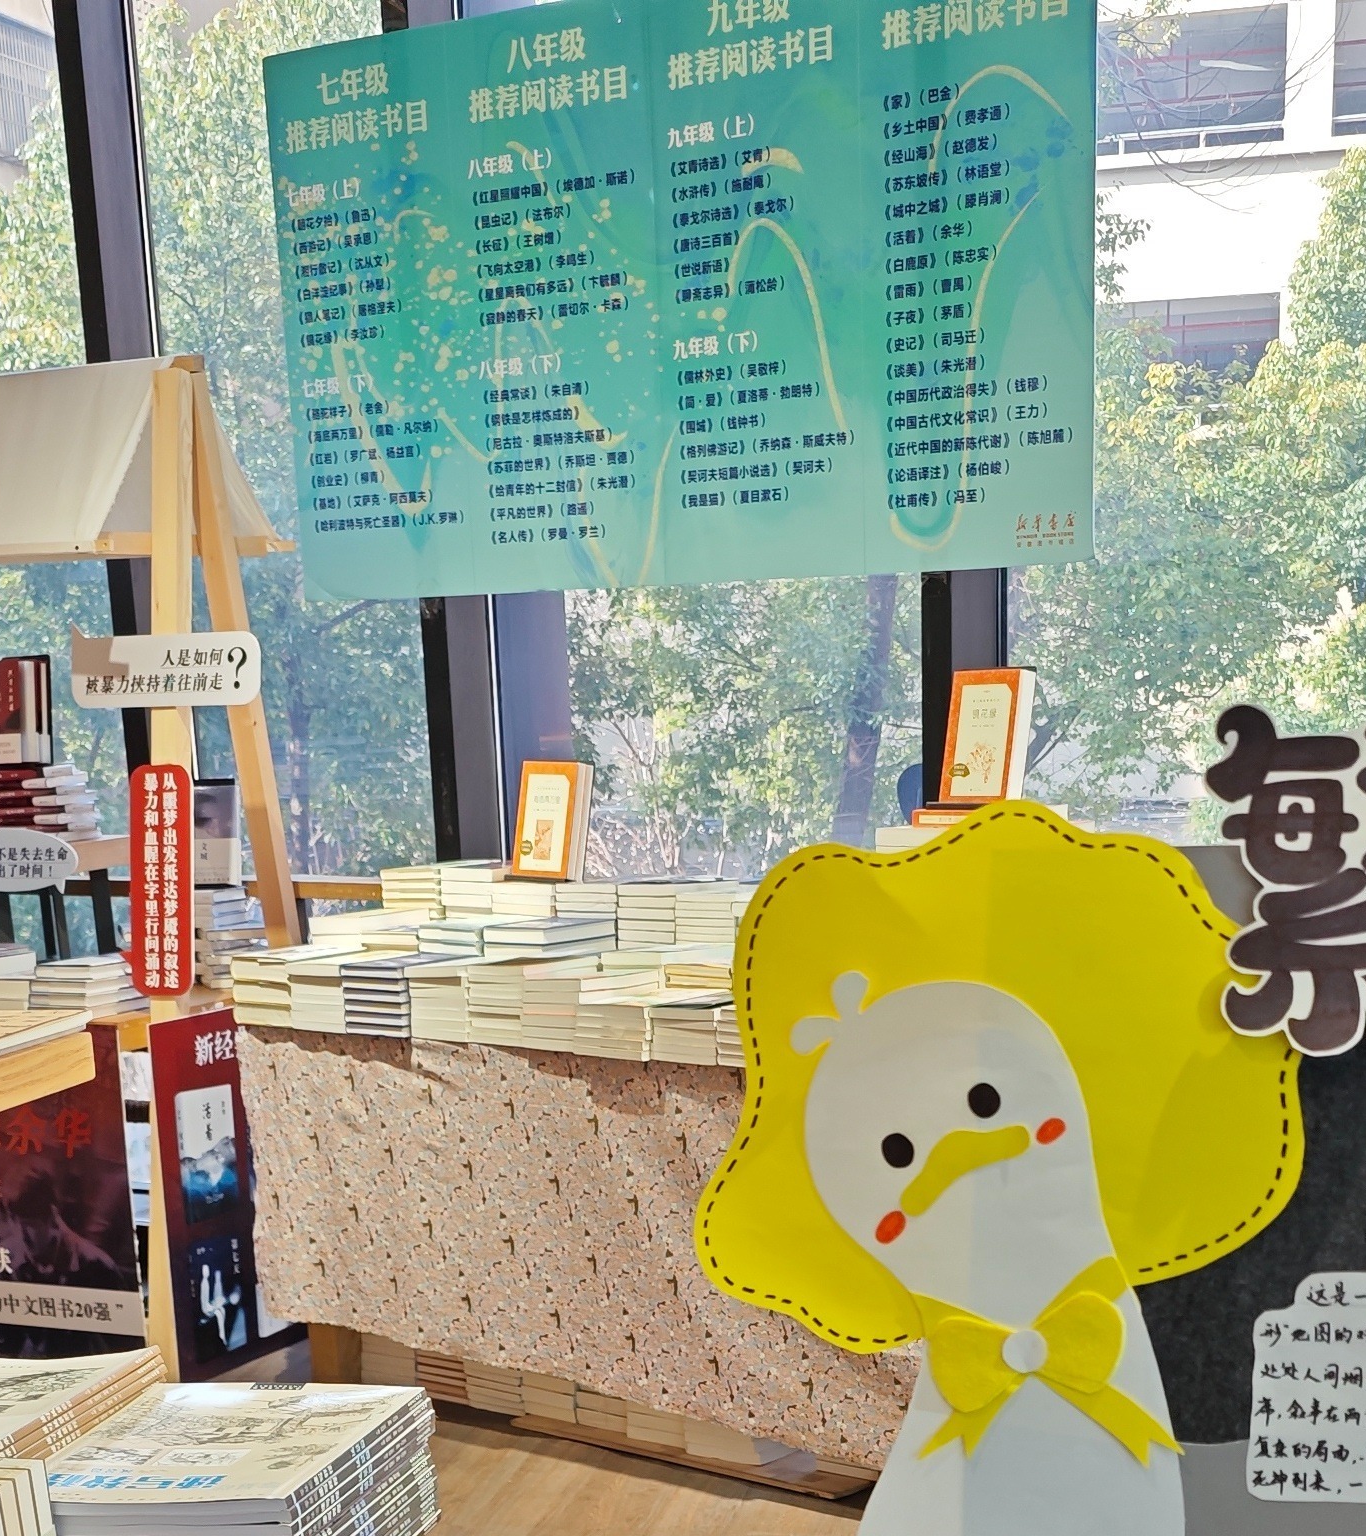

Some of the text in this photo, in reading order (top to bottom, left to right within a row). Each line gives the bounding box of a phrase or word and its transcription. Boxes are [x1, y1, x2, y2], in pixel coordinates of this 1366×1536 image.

[707, 0, 791, 36] 九年级
[881, 0, 1068, 50] 推荐阅读书目
[507, 27, 586, 74] 八年级
[667, 24, 833, 91] 推荐阅读书目
[316, 62, 390, 106] 七年级
[468, 65, 627, 124] 推荐阅读书目
[285, 100, 428, 155] 推荐阅读书目
[161, 648, 224, 668] 人是如何
[85, 674, 224, 696] 被暴力挟持着往前走
[144, 773, 160, 988] 暴力和血腥在字里行间涌动
[194, 1026, 247, 1067] 新经
